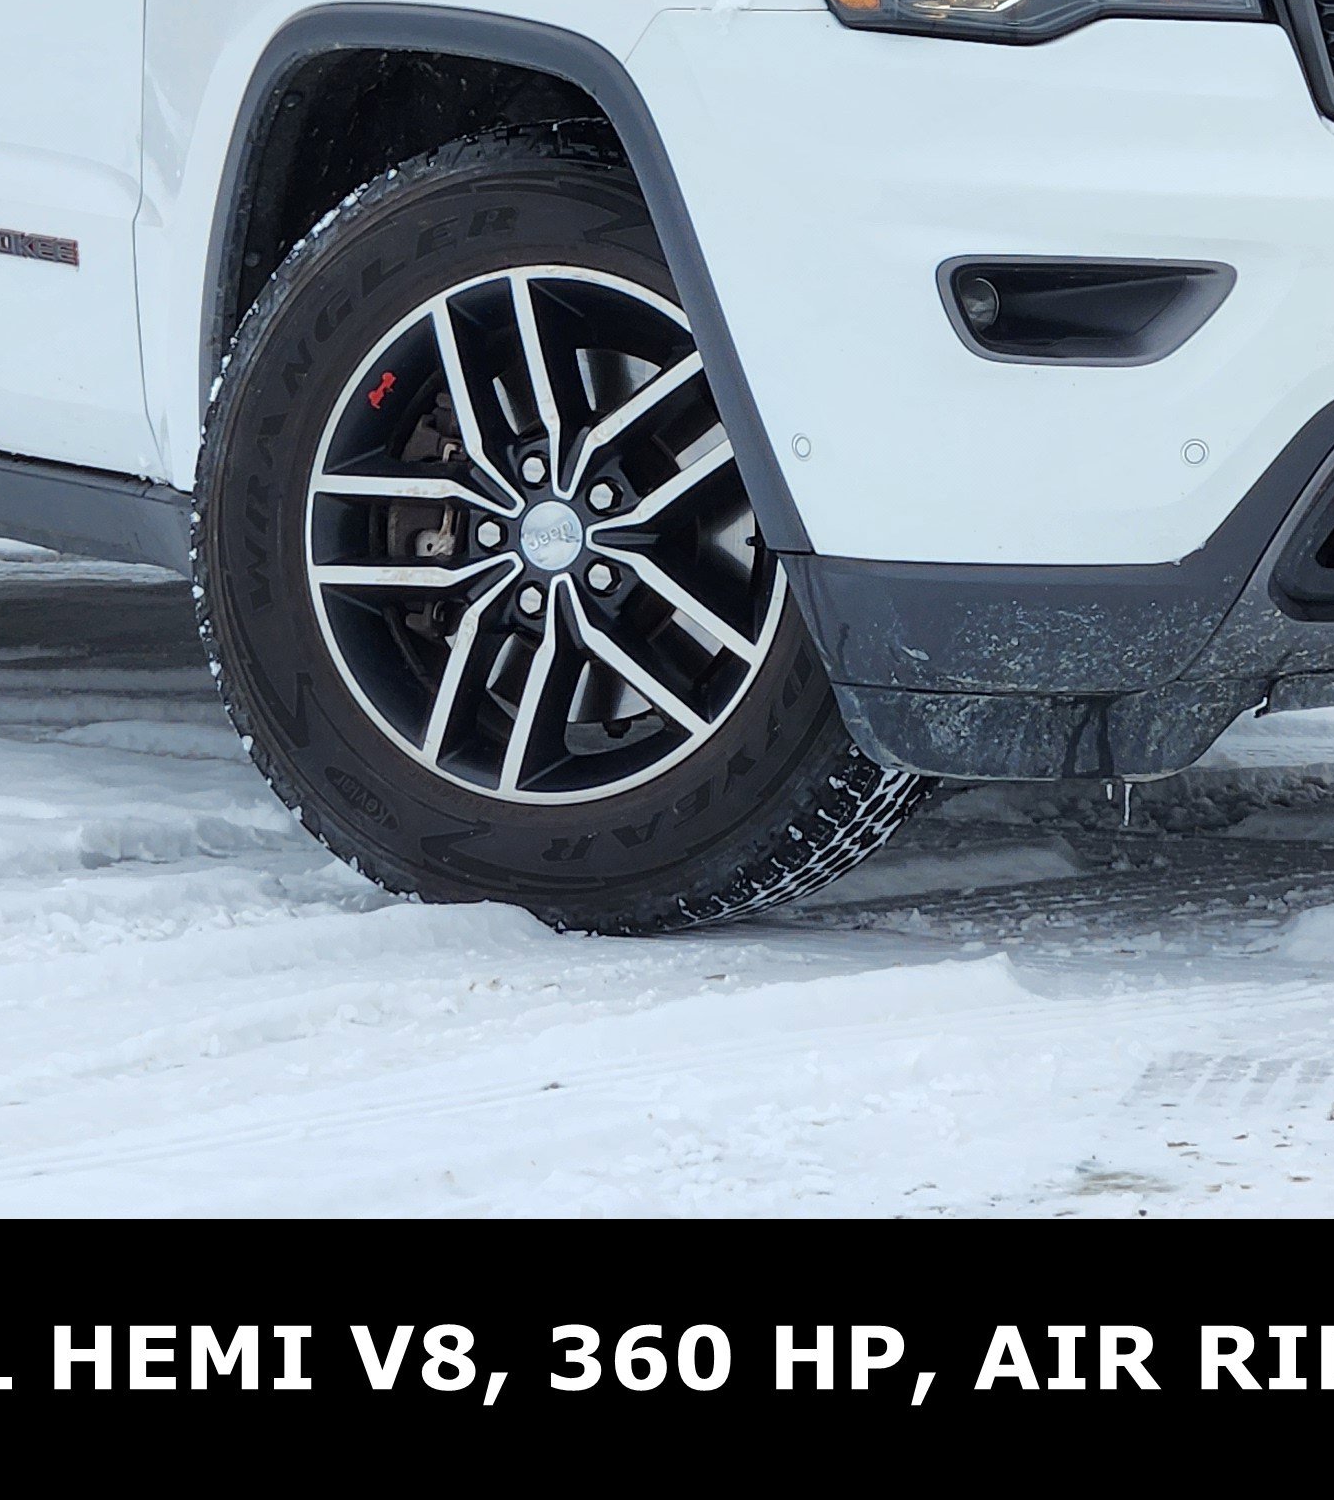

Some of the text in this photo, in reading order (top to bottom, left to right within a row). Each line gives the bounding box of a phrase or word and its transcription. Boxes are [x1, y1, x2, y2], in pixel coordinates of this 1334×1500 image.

[243, 205, 520, 613] WRANGLER
[528, 520, 575, 552] Jeep
[540, 636, 816, 863] DYEAR
